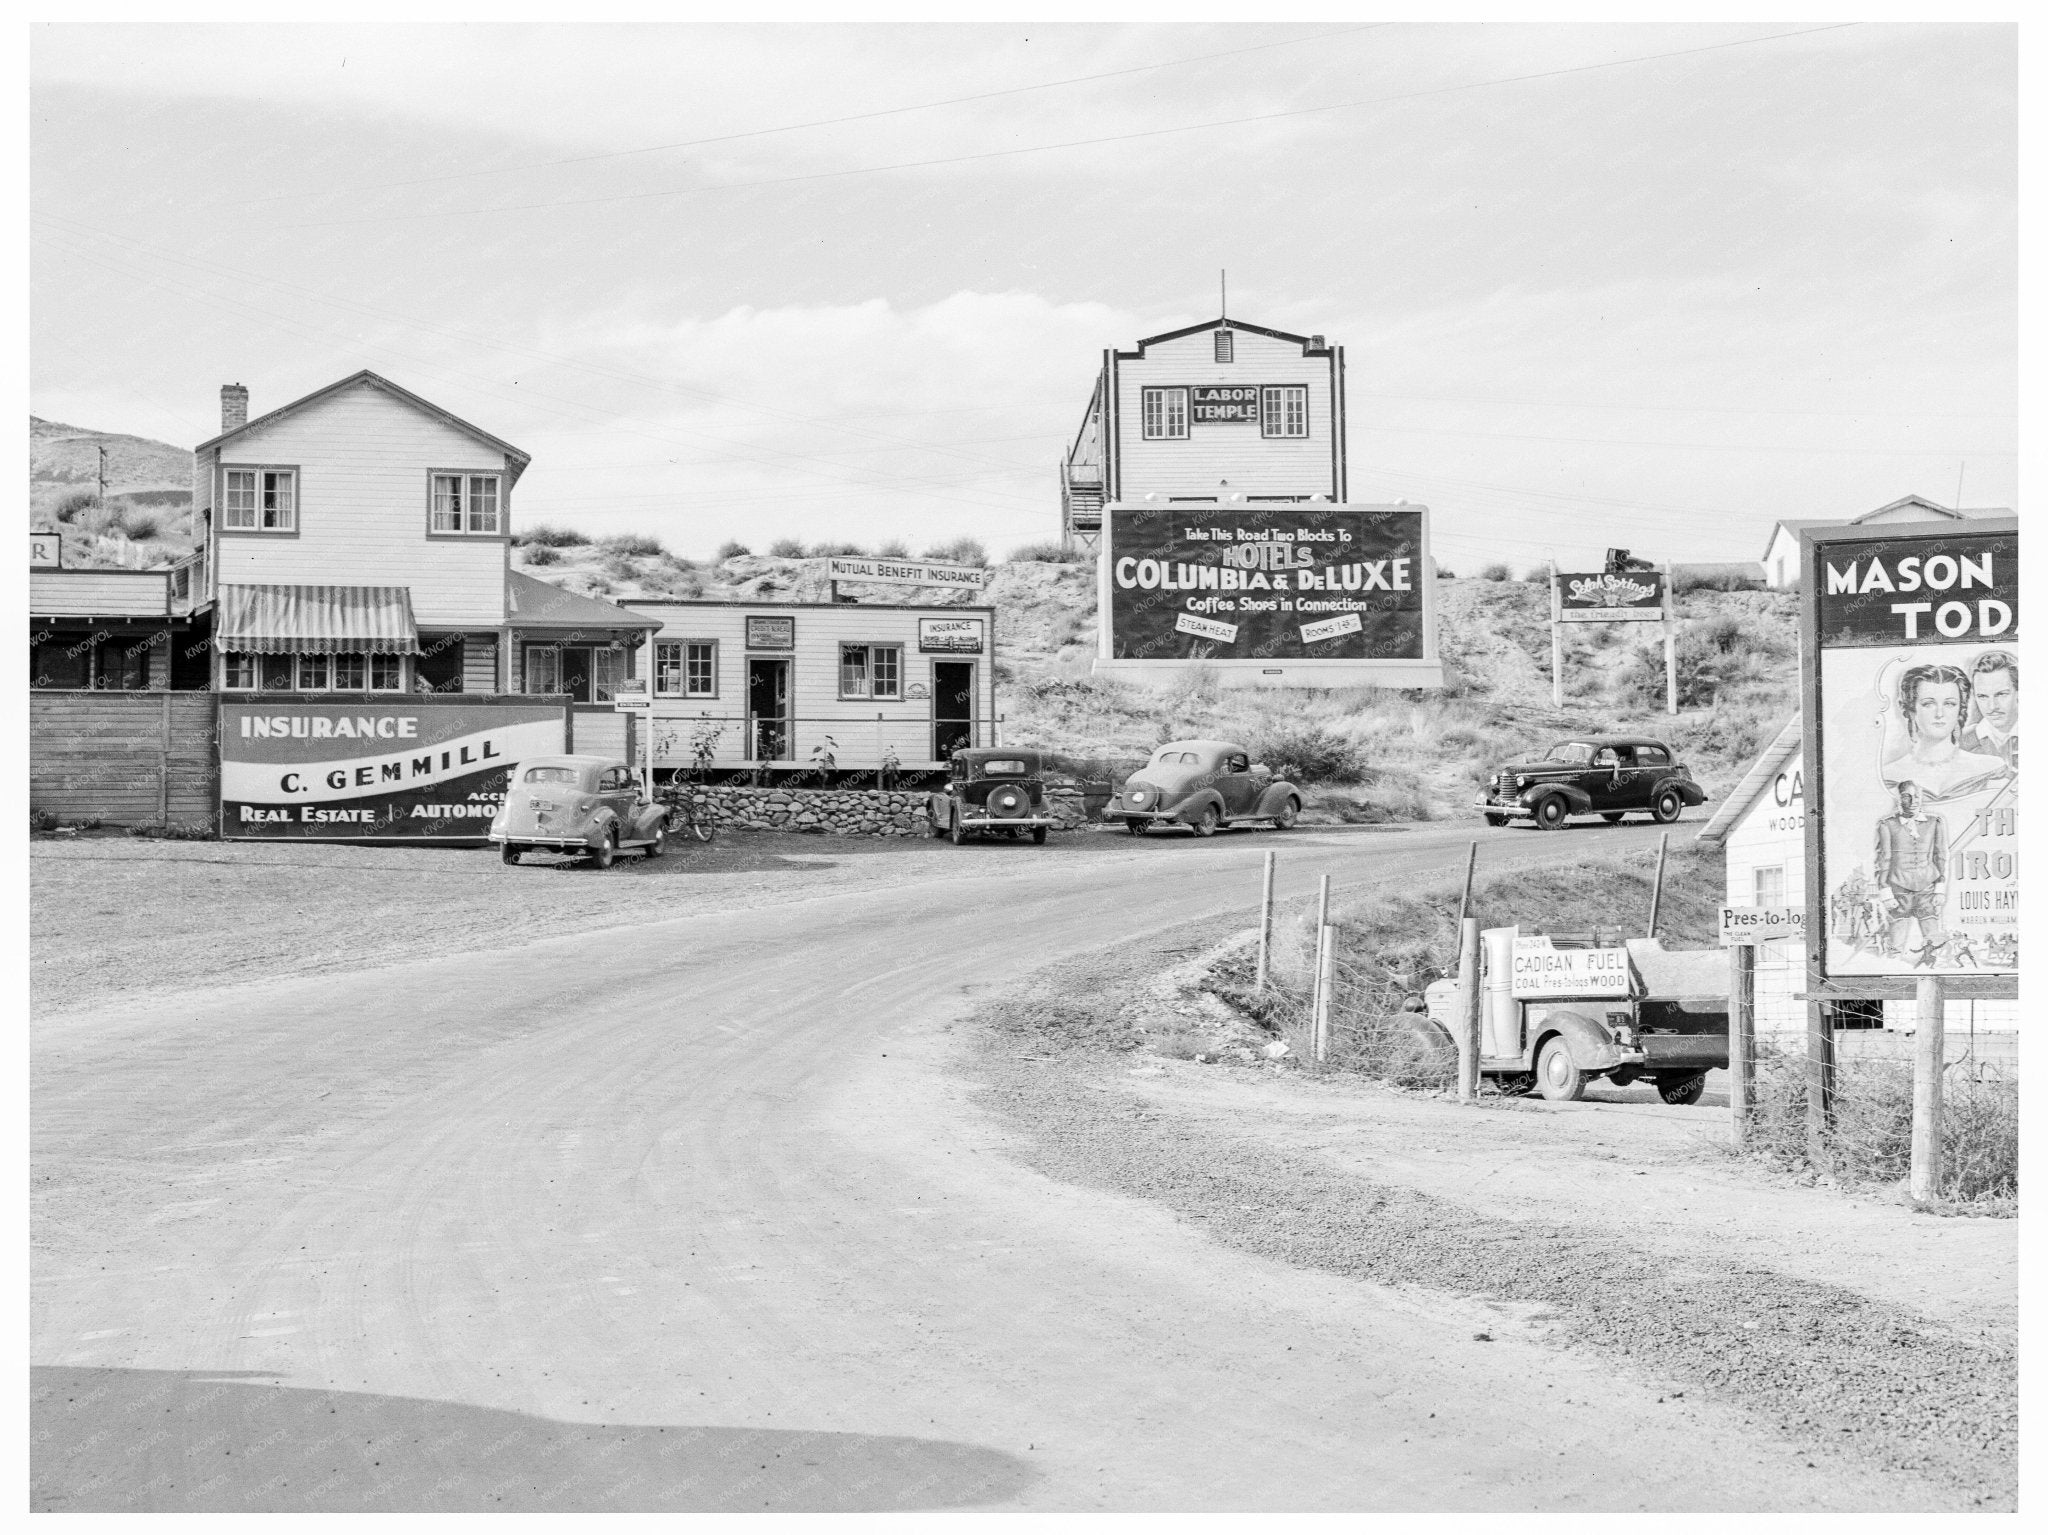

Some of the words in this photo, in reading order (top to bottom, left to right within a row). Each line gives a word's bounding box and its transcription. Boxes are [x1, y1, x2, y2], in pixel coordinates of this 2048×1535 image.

[1195, 389, 1256, 401] LABOR
[1194, 405, 1257, 419] TEMPLE
[1185, 528, 1210, 541] Take
[1210, 528, 1233, 541] This
[1237, 528, 1269, 541] Road
[1272, 529, 1295, 541] Two
[1297, 529, 1335, 542] Blocks
[1336, 530, 1352, 542] To
[1223, 542, 1313, 570] HOTELS
[832, 560, 874, 576] MUTUAL
[878, 563, 923, 580] BENEFIT
[928, 567, 981, 584] INSURANCE
[1115, 556, 1272, 590] COLUMBIA
[1272, 574, 1288, 590] &
[1826, 552, 1994, 596] MASON
[1604, 574, 1657, 601] Springs
[1186, 597, 1235, 613] Coffee
[1239, 597, 1278, 611] Shops
[1280, 597, 1293, 611] in
[1296, 597, 1367, 611] Connection
[929, 621, 972, 633] INSURANCE
[1179, 618, 1208, 632] STEAM
[1208, 623, 1234, 638] HEAT
[1890, 599, 2018, 639] TOD
[1305, 624, 1335, 639] ROOMS
[240, 716, 418, 738] INSURANCE
[281, 773, 308, 793] C.
[327, 740, 501, 790] GEMMILL
[240, 806, 293, 823] REAL
[301, 806, 375, 823] ESTATE
[1975, 807, 2018, 837] TH
[1951, 849, 2018, 881] IRO
[1960, 890, 1991, 910] LOUIS
[1995, 890, 2018, 910] HAY
[1515, 955, 1573, 973] CADIGAN
[1588, 952, 1624, 970] FUEL
[1515, 977, 1540, 989] COAL
[1589, 974, 1625, 988] WOOD
